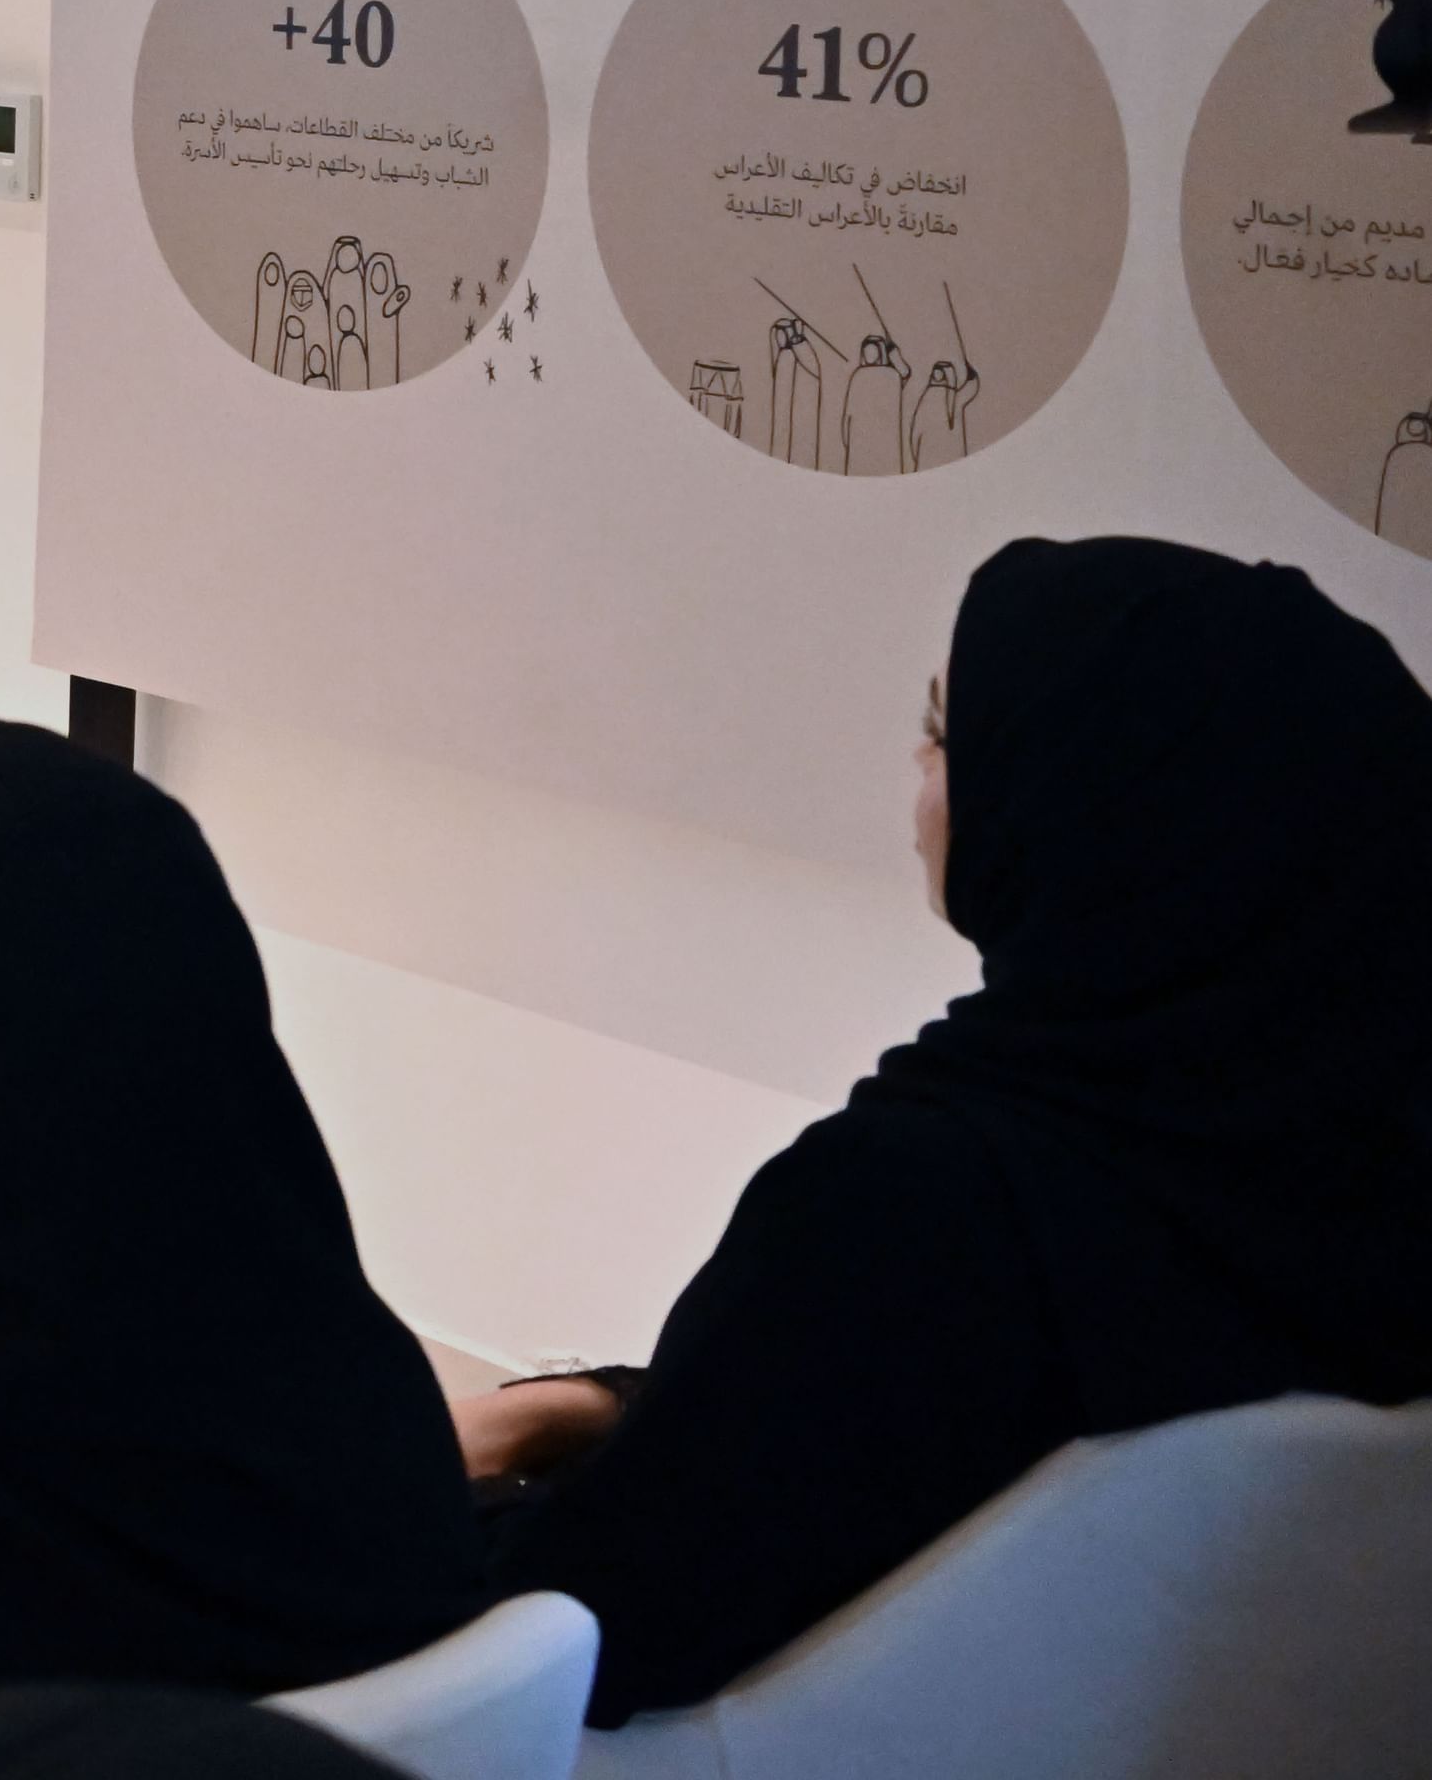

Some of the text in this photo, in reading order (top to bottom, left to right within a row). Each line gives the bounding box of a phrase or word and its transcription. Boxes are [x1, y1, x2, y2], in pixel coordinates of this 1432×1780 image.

[758, 23, 929, 108] 41%
[177, 111, 205, 131] دعم
[210, 107, 226, 136] في
[229, 108, 281, 133] ساهموا
[363, 122, 415, 144] مختلف
[230, 141, 283, 169] تأسيس
[419, 132, 443, 151] من
[286, 151, 313, 172] نحو
[317, 154, 366, 179] رحلتهم
[370, 157, 430, 187] وتسهيل
[712, 151, 966, 198] انخفاض في تكاليف الأعراس
[435, 164, 489, 190] الشباب
[725, 193, 802, 221] التقليدية
[808, 200, 891, 236] بالأعراس
[1232, 199, 1425, 245] مديم من إجمالي
[1309, 251, 1379, 282] كخيار
